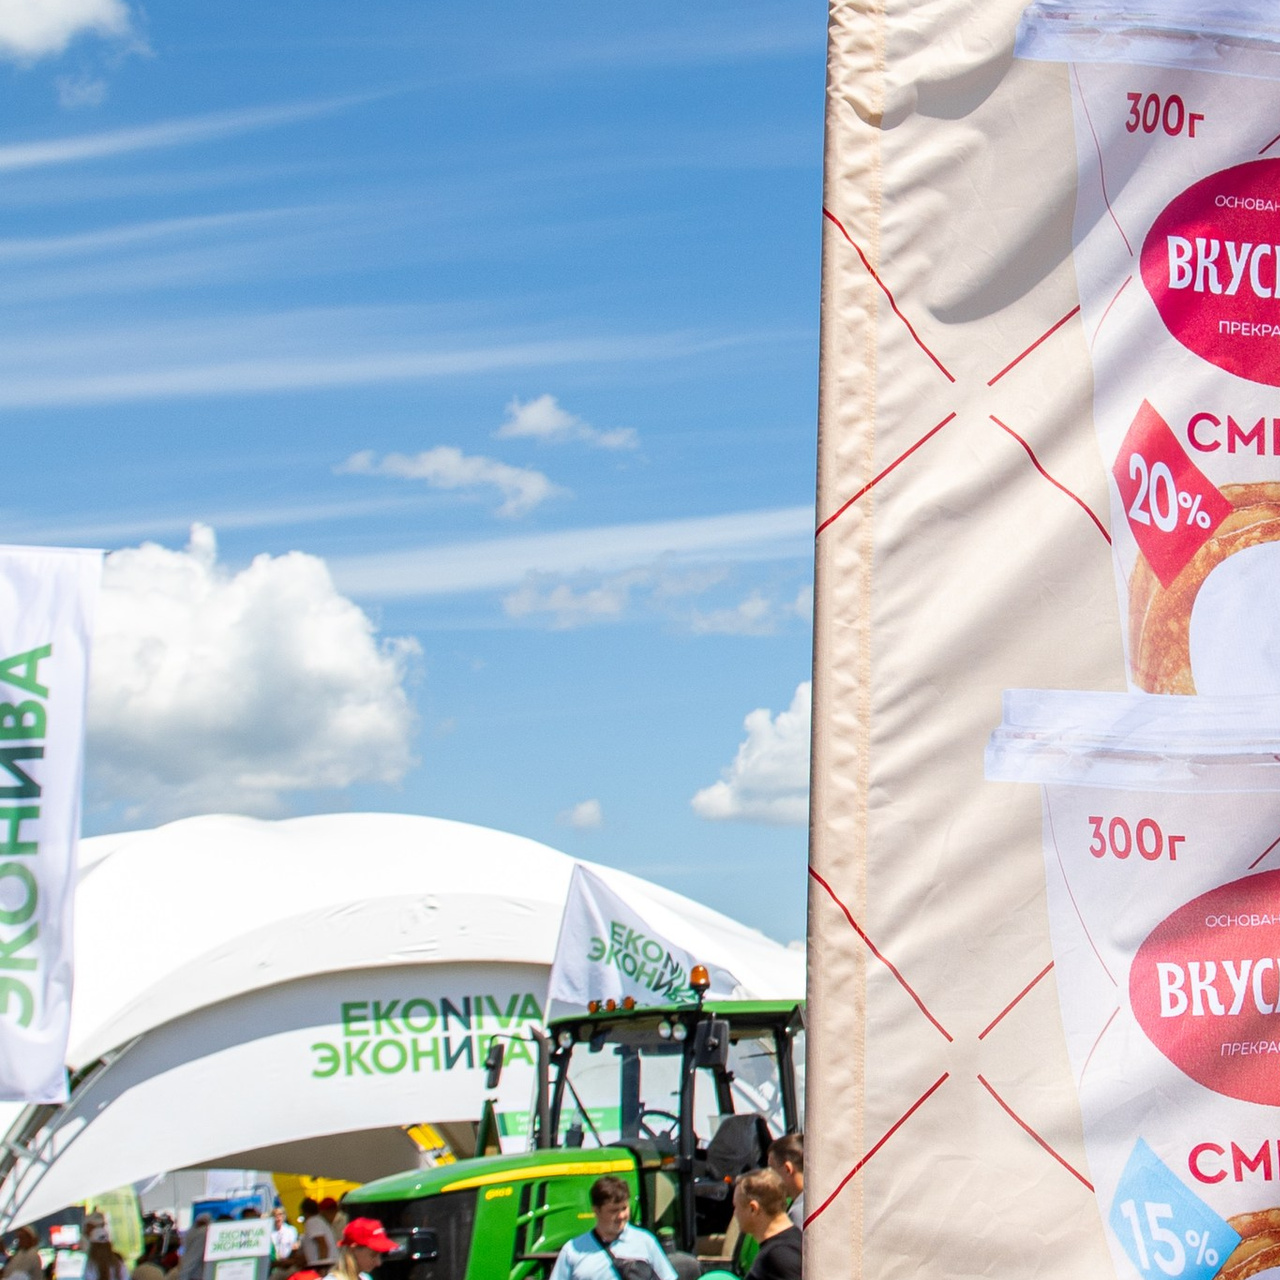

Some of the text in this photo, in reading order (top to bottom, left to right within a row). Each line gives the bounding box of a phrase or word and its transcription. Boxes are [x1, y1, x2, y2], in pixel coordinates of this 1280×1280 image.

[1126, 92, 1205, 139] 300г
[1128, 451, 1212, 534] 20%
[1088, 816, 1187, 862] 300г
[341, 992, 545, 1037] EKONIVA
[1120, 1197, 1220, 1277] 15%
